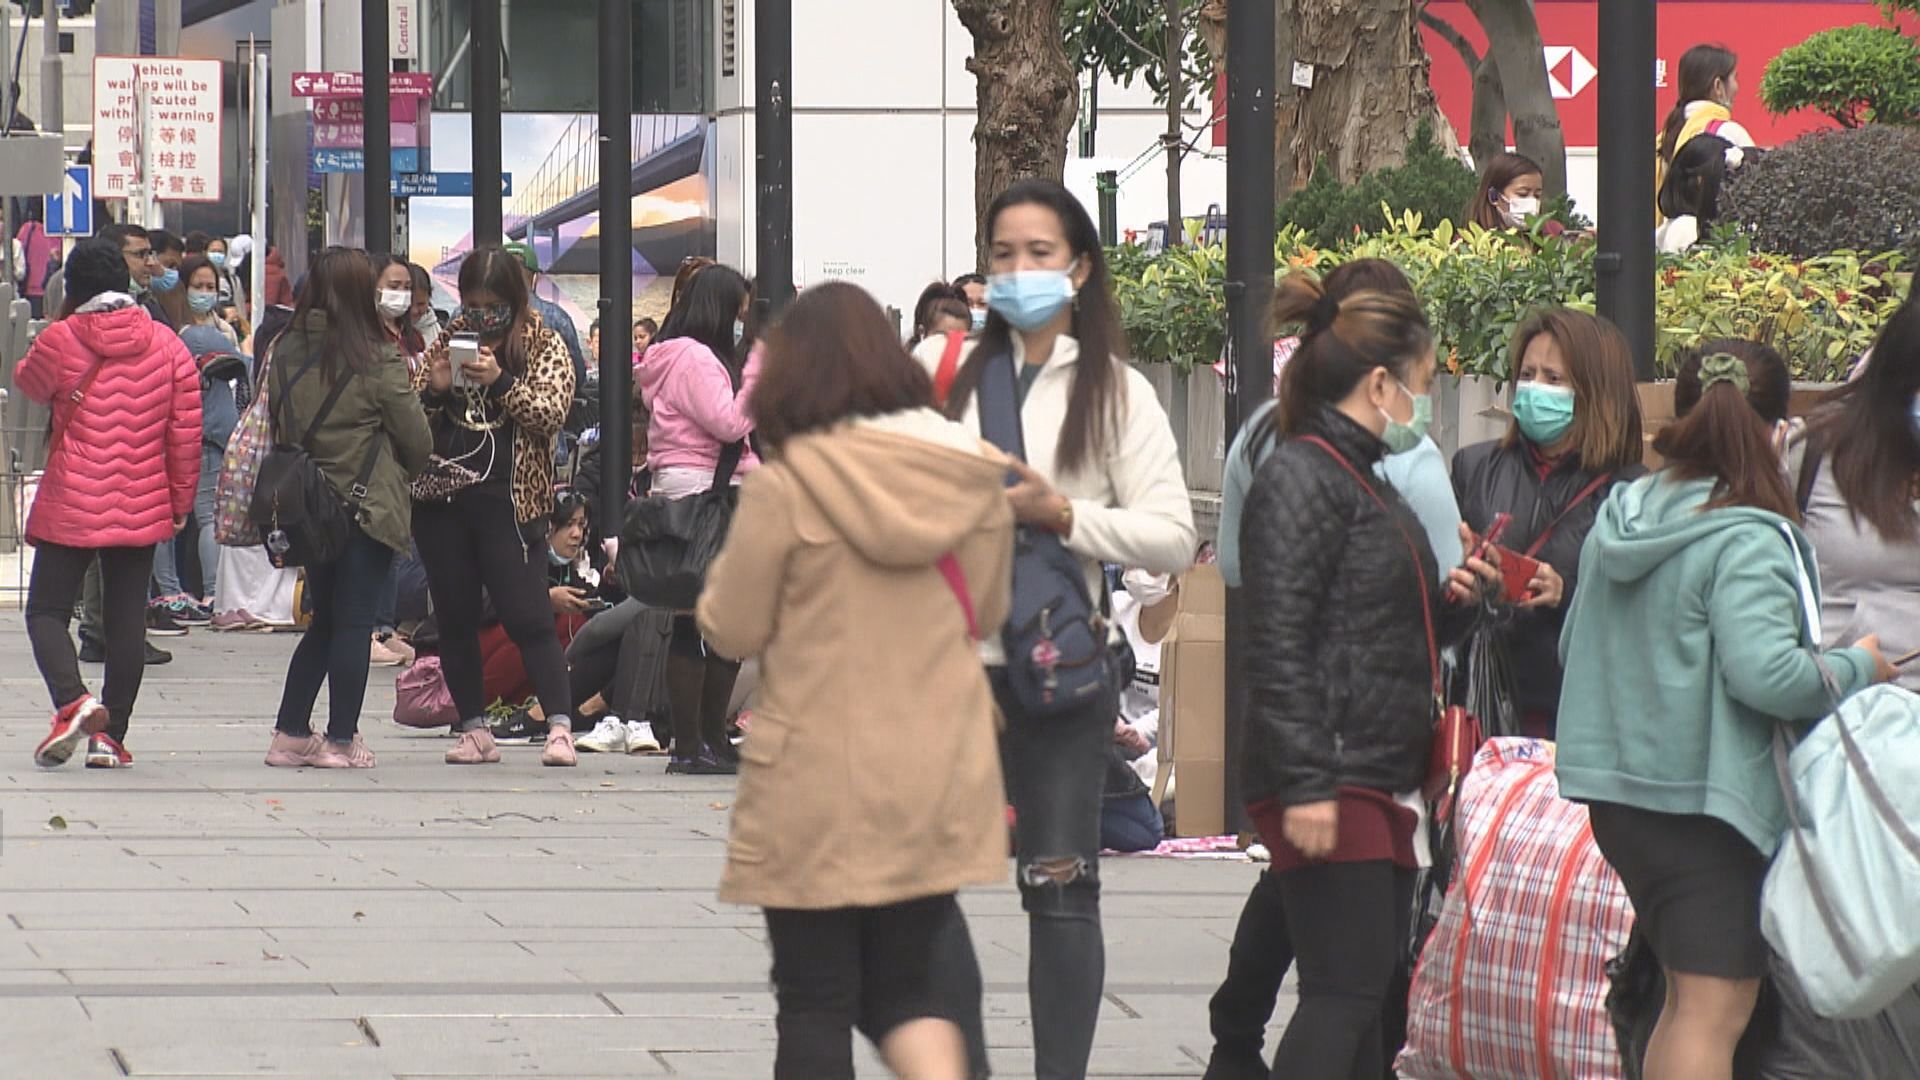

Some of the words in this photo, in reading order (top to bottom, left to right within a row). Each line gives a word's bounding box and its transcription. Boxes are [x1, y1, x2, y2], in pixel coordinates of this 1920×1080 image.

[396, 6, 409, 55] Central
[107, 80, 159, 92] waing
[163, 80, 188, 92] will
[192, 81, 208, 92] be
[159, 110, 215, 123] warning
[118, 126, 197, 145] 停等候
[118, 150, 197, 169] 會檢控
[418, 185, 437, 195] Ferry
[823, 267, 843, 275] keep
[845, 267, 865, 275] clear
